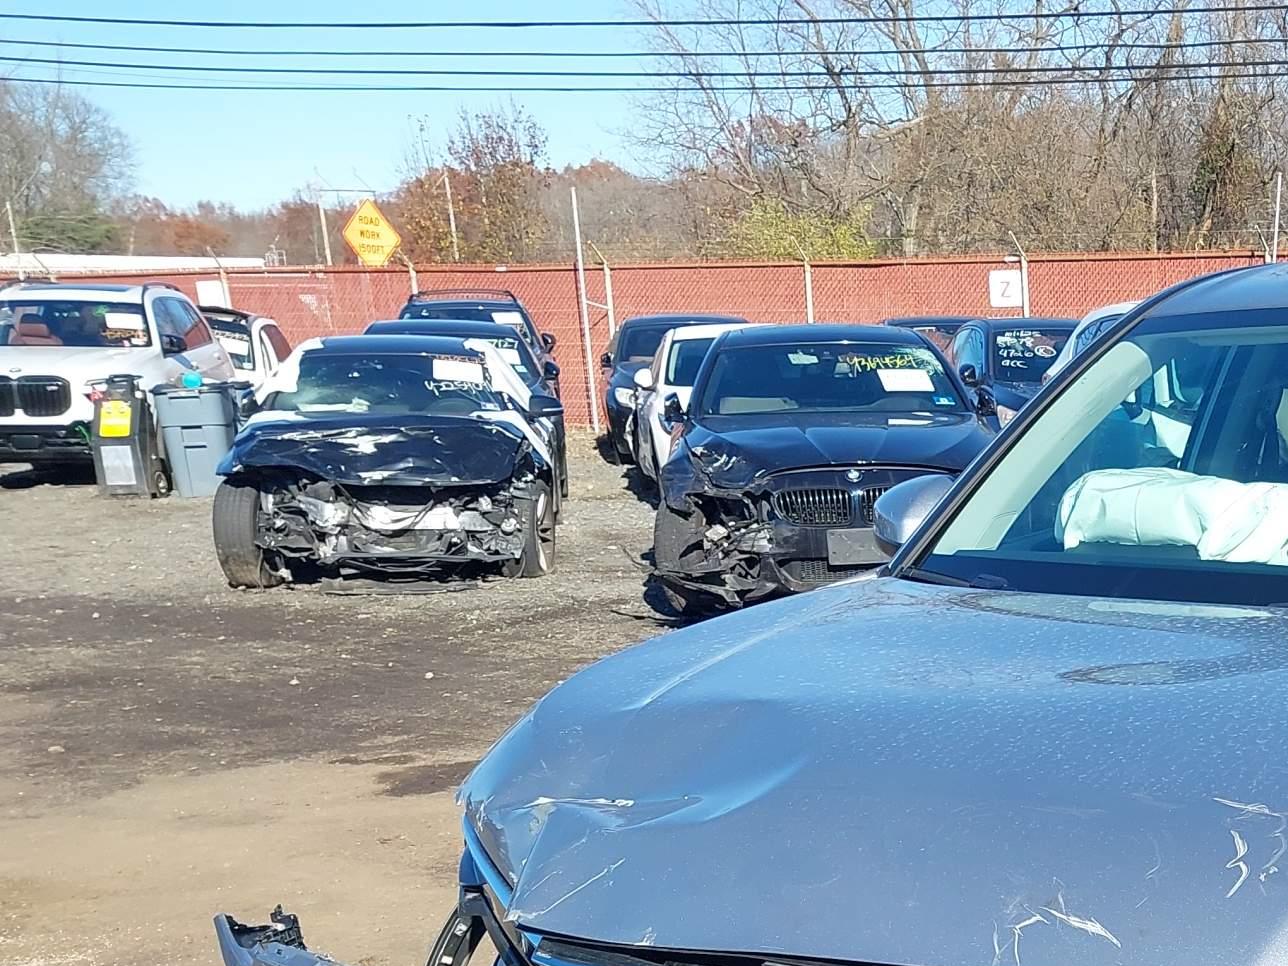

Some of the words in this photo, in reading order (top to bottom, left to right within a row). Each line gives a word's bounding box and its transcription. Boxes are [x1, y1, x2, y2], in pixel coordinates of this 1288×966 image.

[359, 215, 380, 226] ROAD
[360, 230, 380, 240] WORK
[999, 281, 1012, 298] Z
